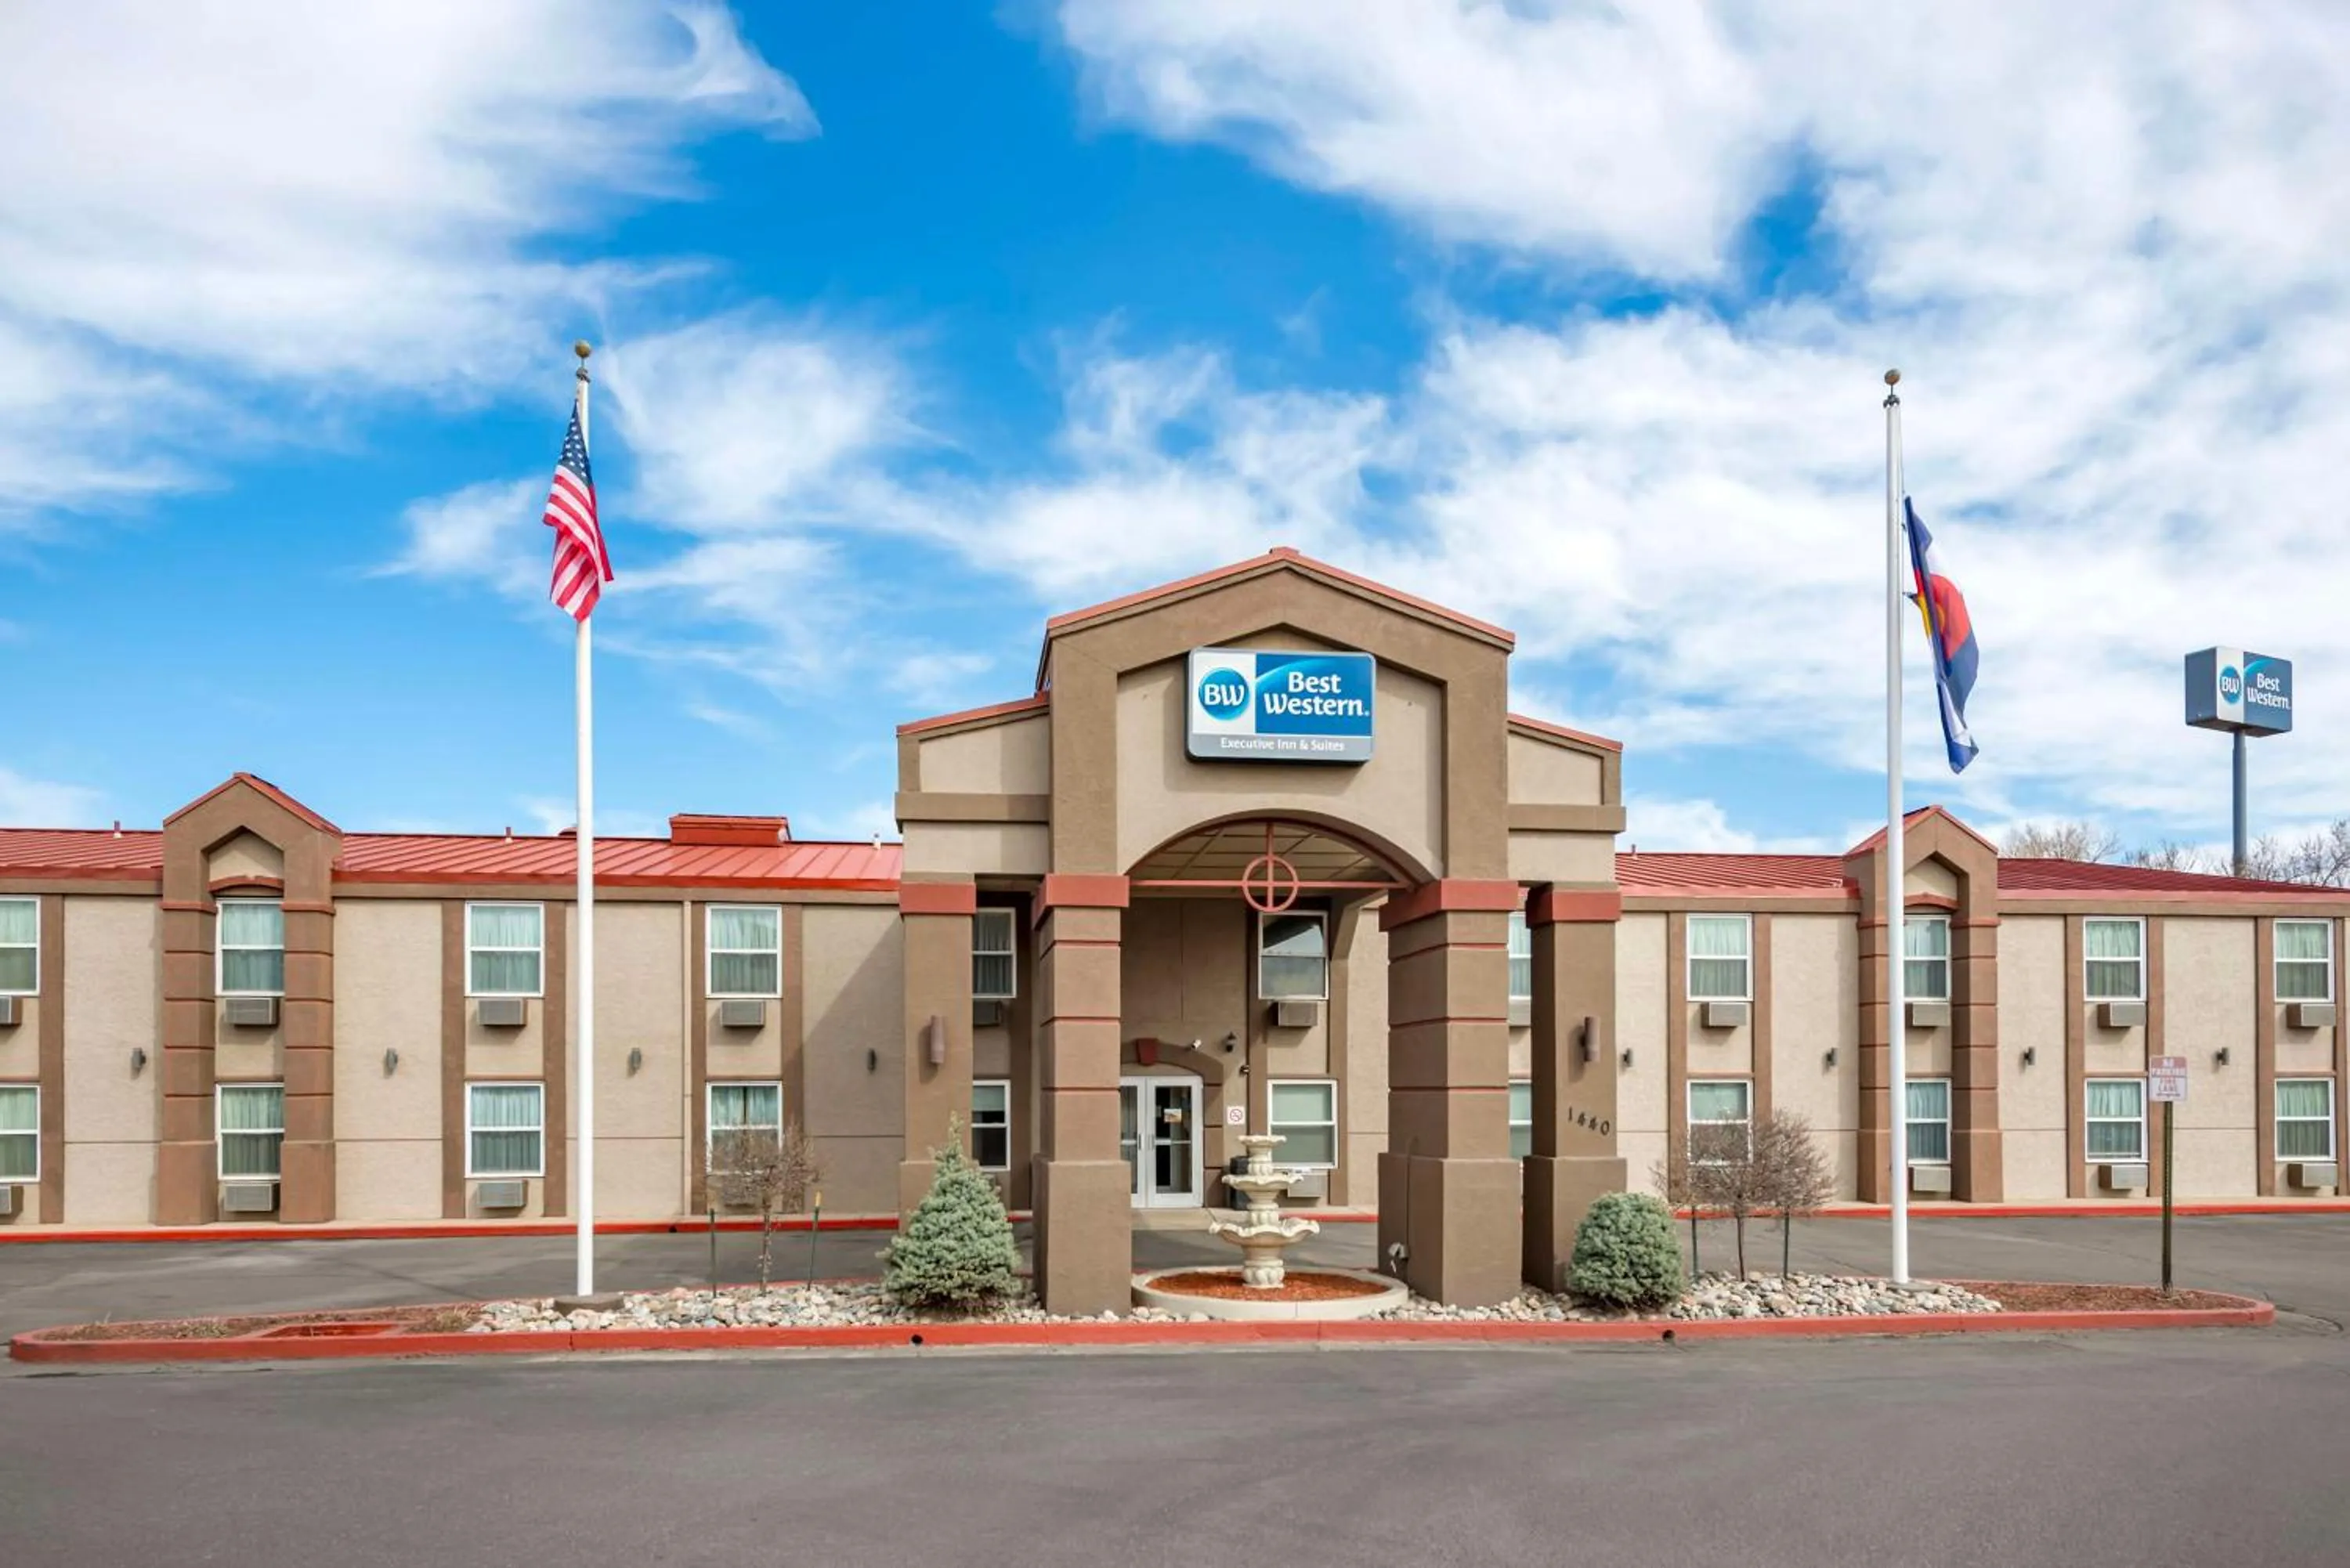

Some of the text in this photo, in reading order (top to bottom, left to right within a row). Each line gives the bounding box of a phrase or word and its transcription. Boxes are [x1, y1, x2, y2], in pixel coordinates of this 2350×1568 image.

[1289, 671, 1341, 694] Best
[2221, 676, 2240, 693] BW
[2257, 673, 2280, 692] Best
[1204, 684, 1245, 706] BW
[1220, 737, 1346, 751] Executive Inn & Suites
[1568, 1105, 1611, 1136] 1440
